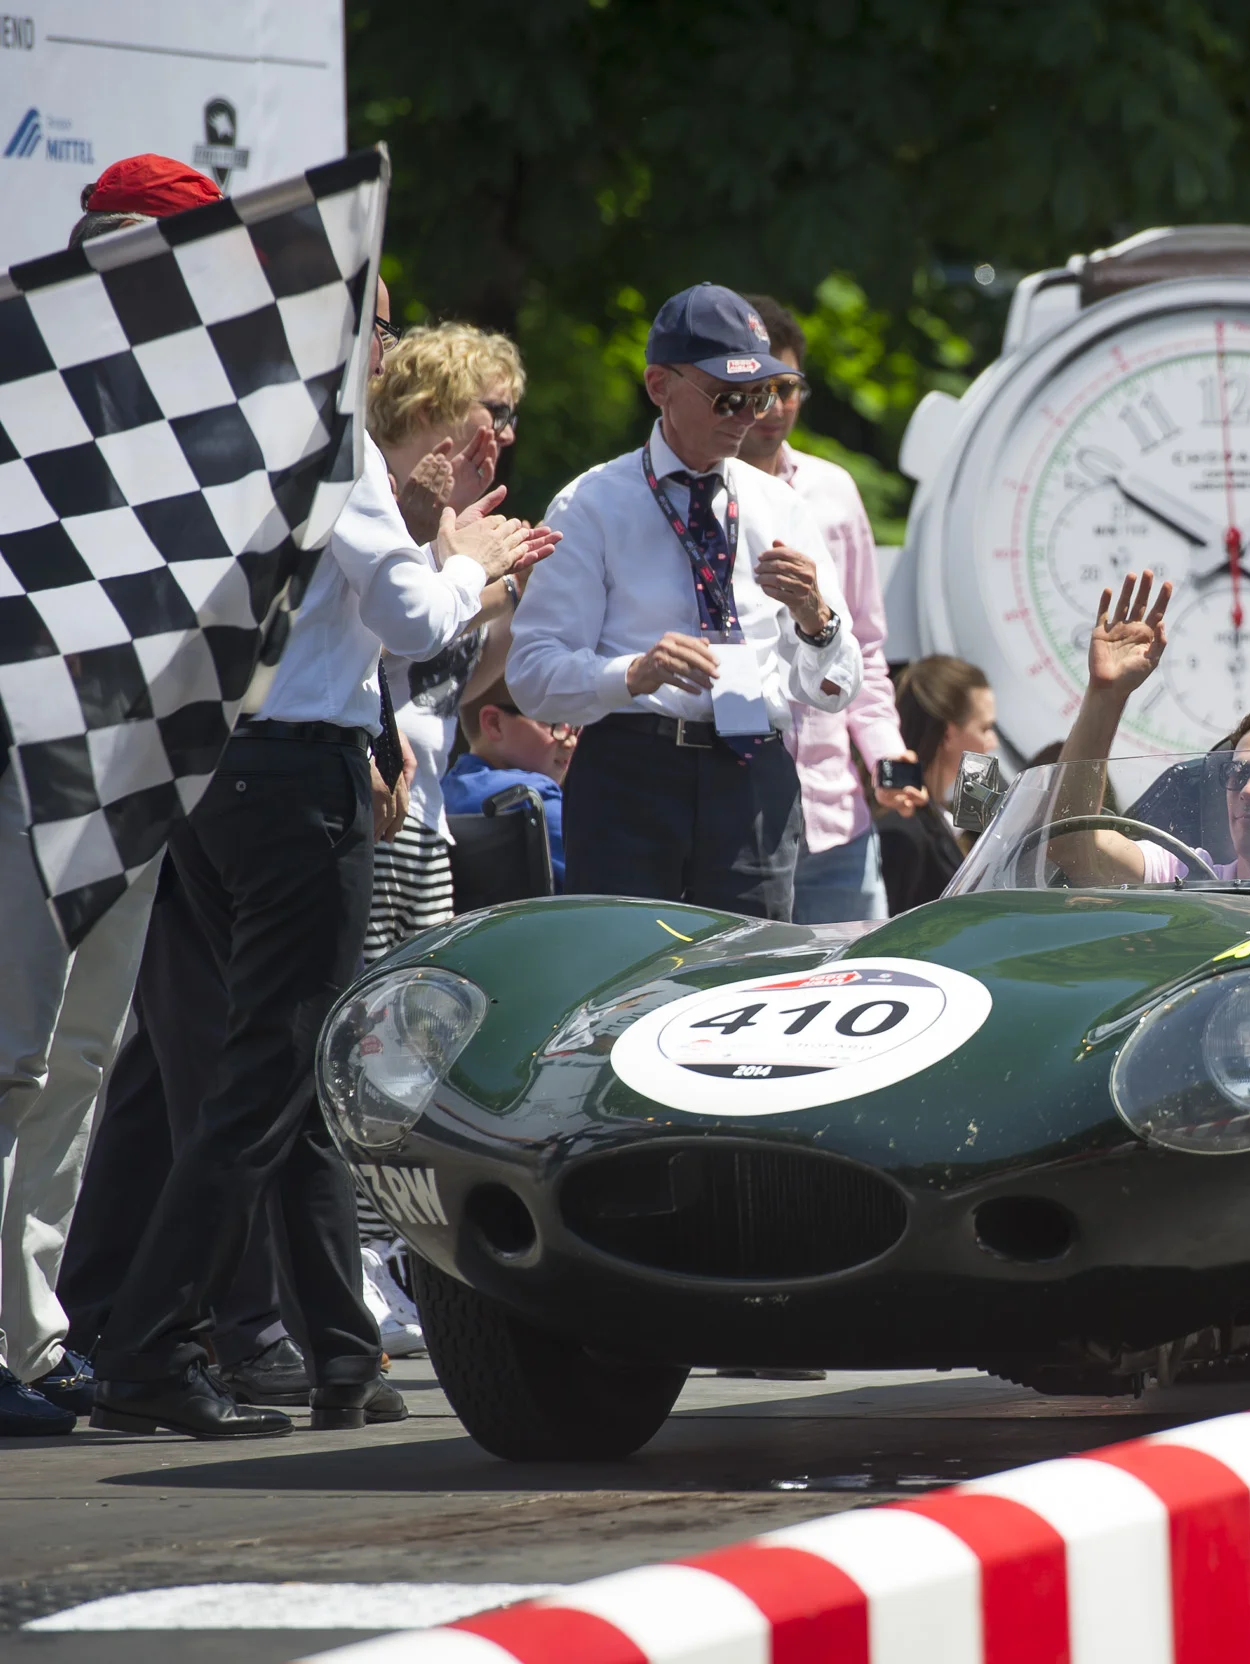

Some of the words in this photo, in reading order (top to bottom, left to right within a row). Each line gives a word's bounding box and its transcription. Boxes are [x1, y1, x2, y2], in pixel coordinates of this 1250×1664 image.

[1118, 391, 1183, 453] 11
[689, 1000, 910, 1037] 410
[732, 1064, 773, 1078] 2014
[349, 1163, 449, 1226] 3RW
